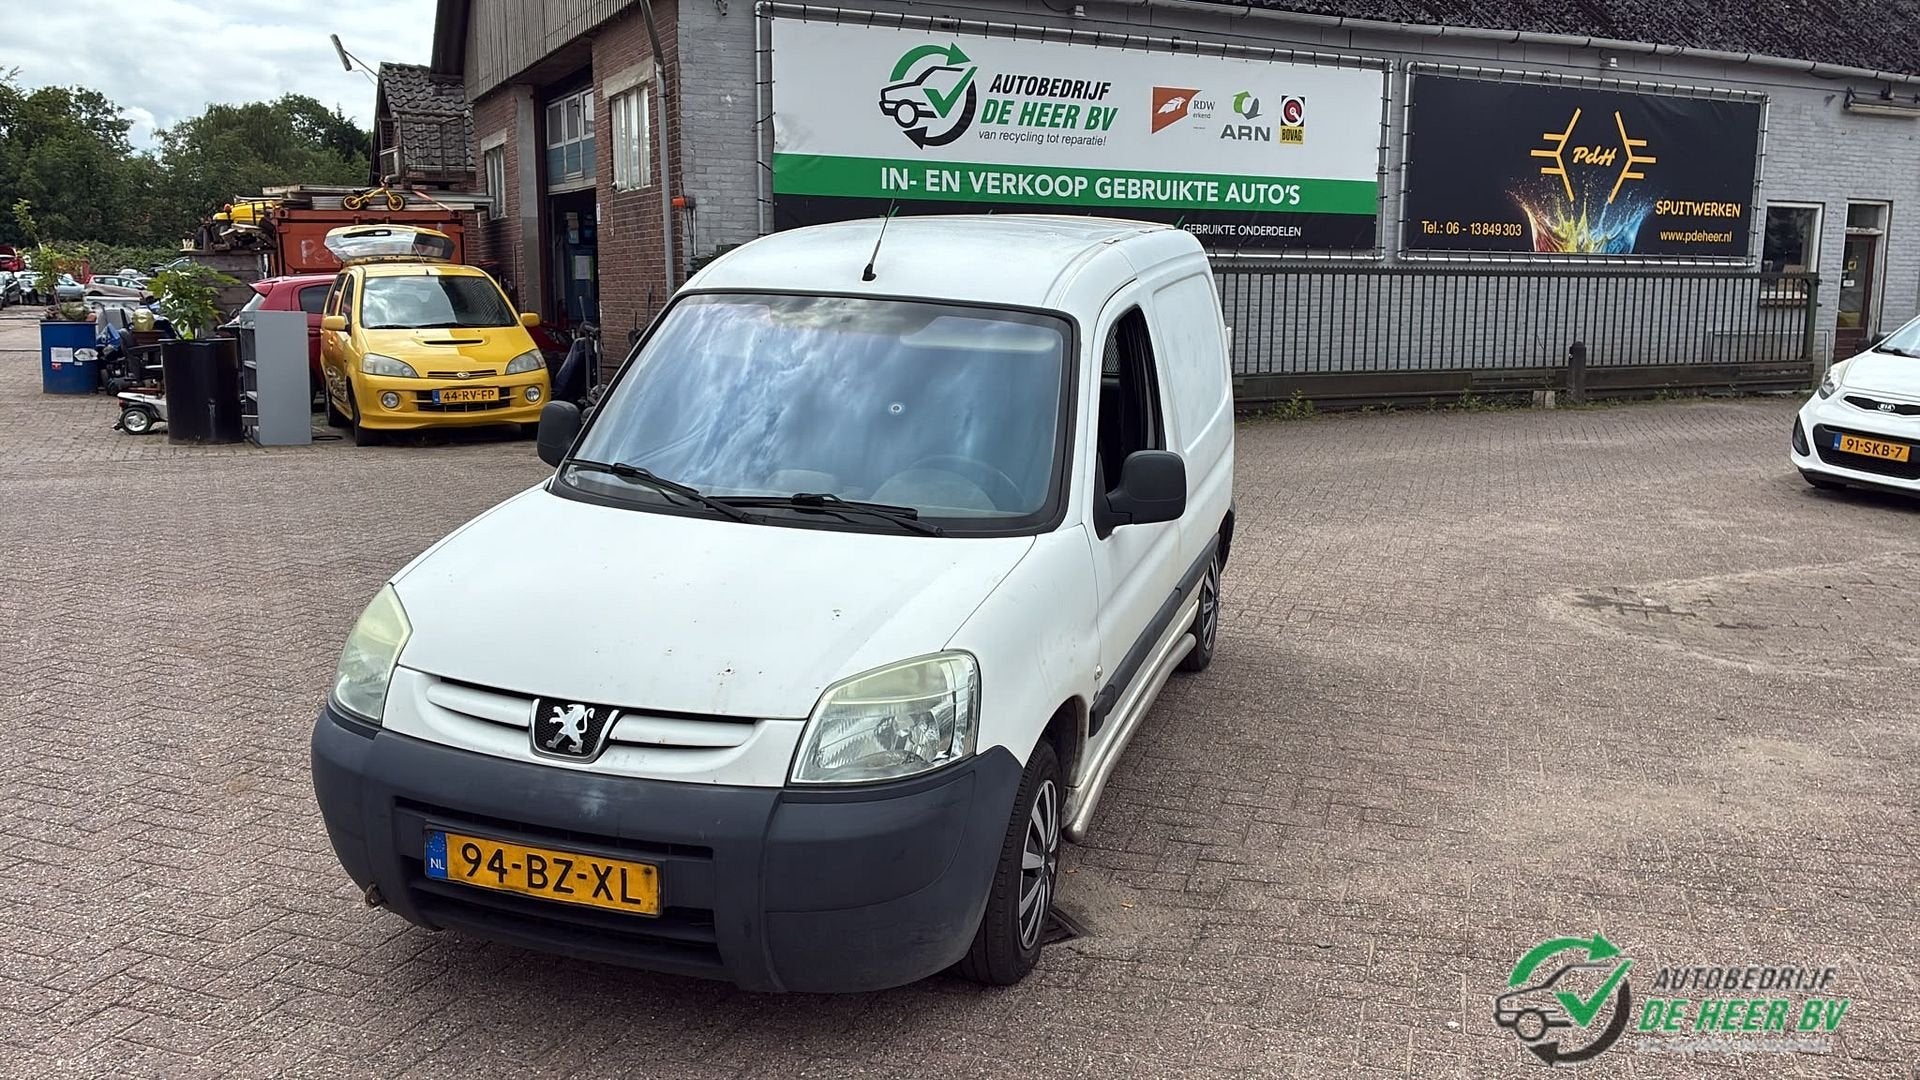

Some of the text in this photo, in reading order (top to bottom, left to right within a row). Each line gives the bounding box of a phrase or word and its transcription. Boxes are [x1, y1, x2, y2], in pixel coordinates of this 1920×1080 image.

[988, 73, 1112, 101] AUTOBEDRIJF
[1193, 99, 1216, 111] RDW
[980, 98, 1119, 131] DE HEER BV
[978, 130, 1107, 147] van recycling tot reparatie!
[1220, 124, 1271, 142] ARN
[1281, 128, 1303, 142] BOVAG
[881, 167, 1300, 205] IN- EN VERKOOP GEBRUIKTE AUTO'S
[1655, 200, 1741, 218] SPUITWERKEN
[1182, 224, 1301, 237] GEBRUIKTE ONDERDELEN
[1421, 220, 1443, 234] Tel.:
[1446, 221, 1460, 235] 06
[1660, 230, 1732, 244] www.pdeheer.nl
[443, 389, 495, 402] 44-RV-FP
[1846, 438, 1903, 459] 91-SKB-7
[430, 842, 641, 905] NL 94-BZ-XL
